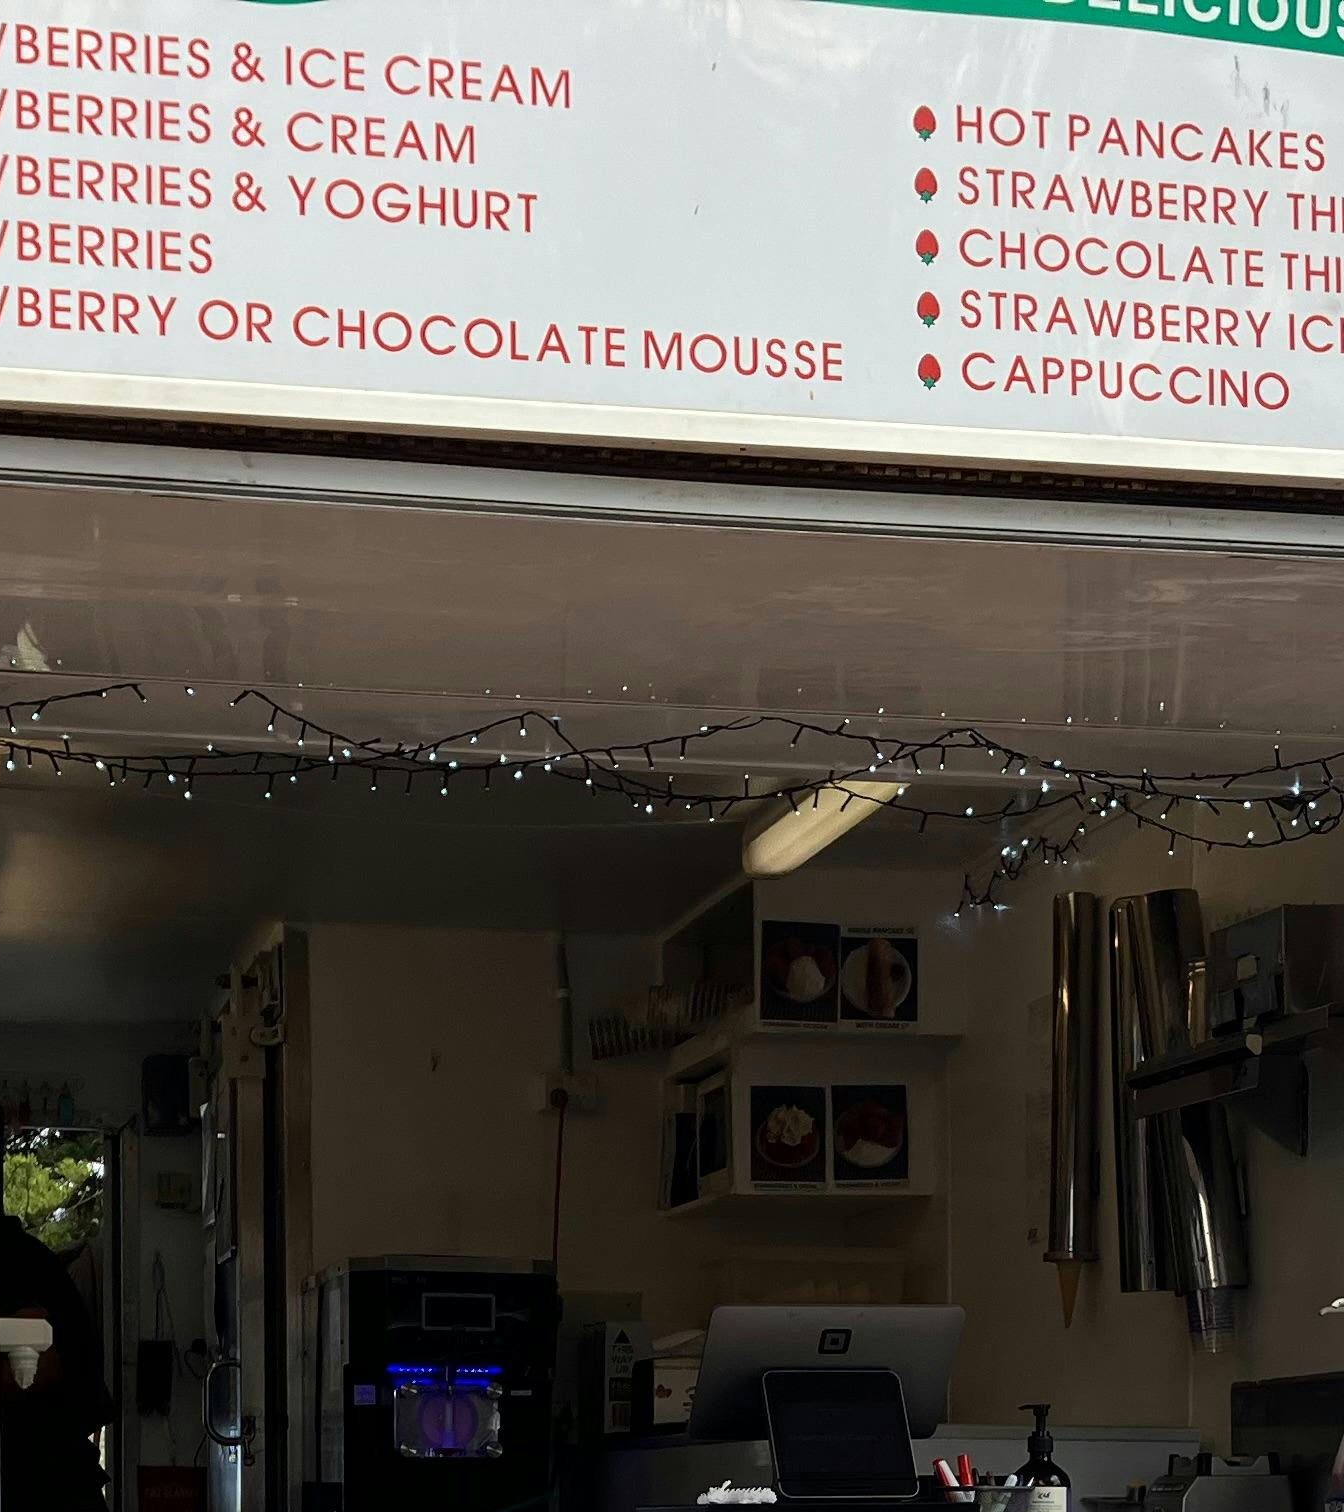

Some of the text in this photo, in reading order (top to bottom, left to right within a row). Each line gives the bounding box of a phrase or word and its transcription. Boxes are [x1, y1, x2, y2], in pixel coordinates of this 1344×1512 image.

[231, 42, 266, 83] &
[285, 47, 364, 92] ICE
[384, 54, 571, 108] CREAM
[232, 107, 266, 148] &
[287, 111, 476, 164] CREAM
[956, 105, 1326, 173] HOT PANCAKES
[232, 171, 267, 213] &
[288, 176, 537, 232] YOGHURT
[959, 165, 1269, 227] STRAWBERRY
[959, 227, 1264, 288] CHOCOLATE
[198, 299, 273, 344] OR
[292, 305, 625, 368] CHOCOLATE
[643, 330, 842, 382] MOUSSE
[960, 289, 1272, 347] STRAWBERRY
[961, 352, 1290, 411] CAPPUCCINO
